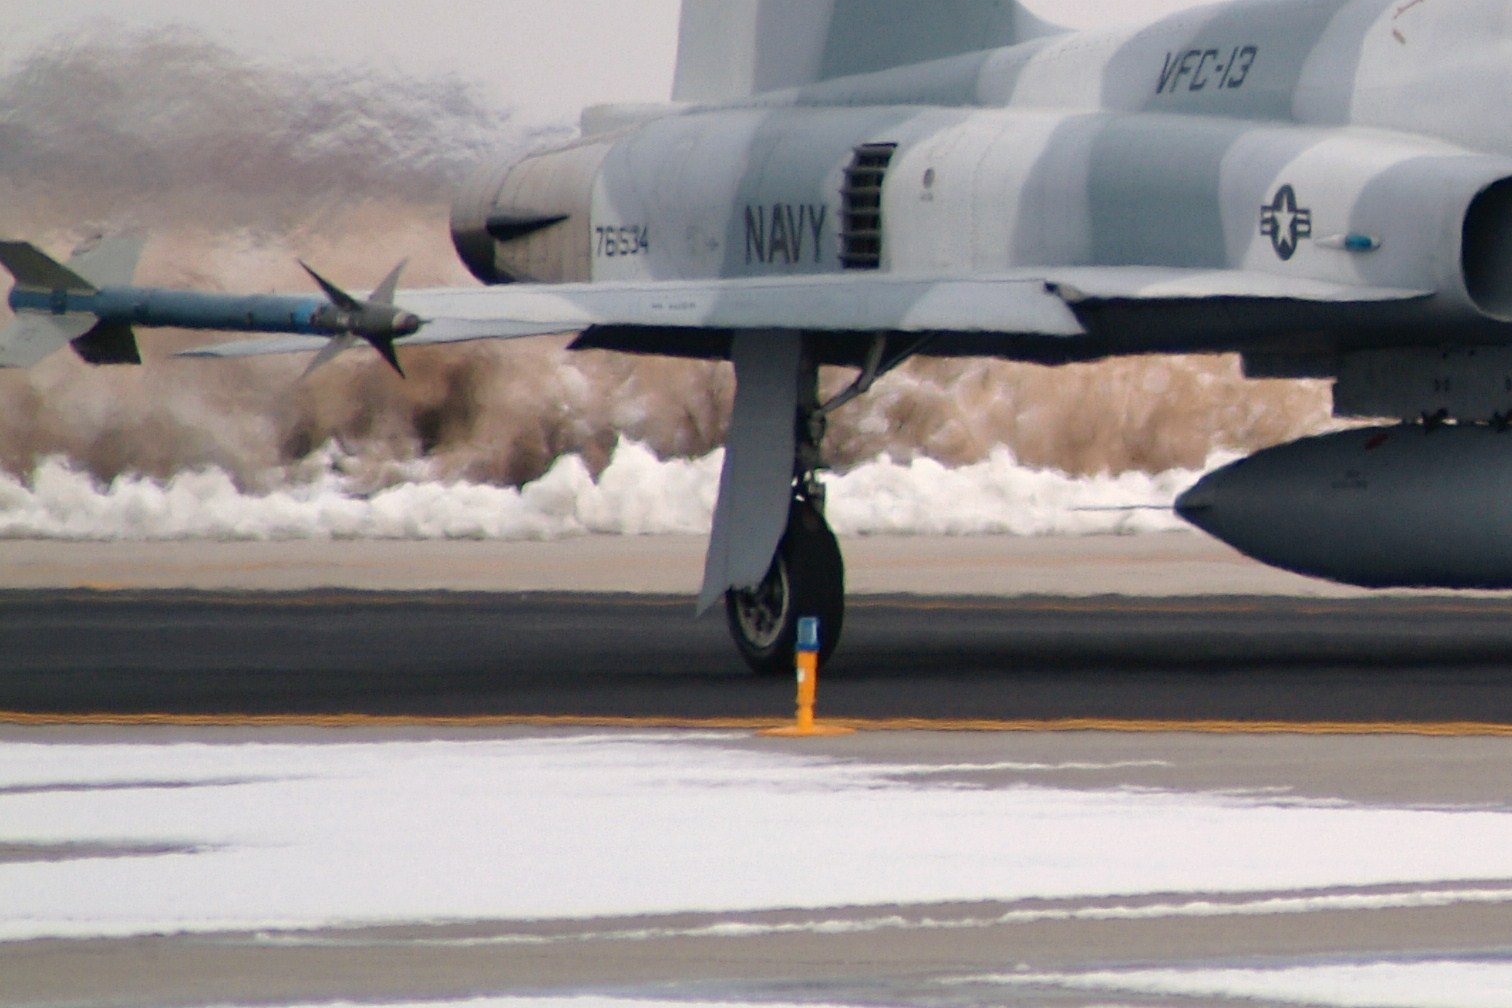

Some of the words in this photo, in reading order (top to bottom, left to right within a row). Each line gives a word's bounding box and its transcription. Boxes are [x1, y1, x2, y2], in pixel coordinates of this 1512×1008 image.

[1155, 45, 1258, 94] VFC-13
[596, 224, 649, 258] 76534
[744, 202, 827, 265] NAVY
